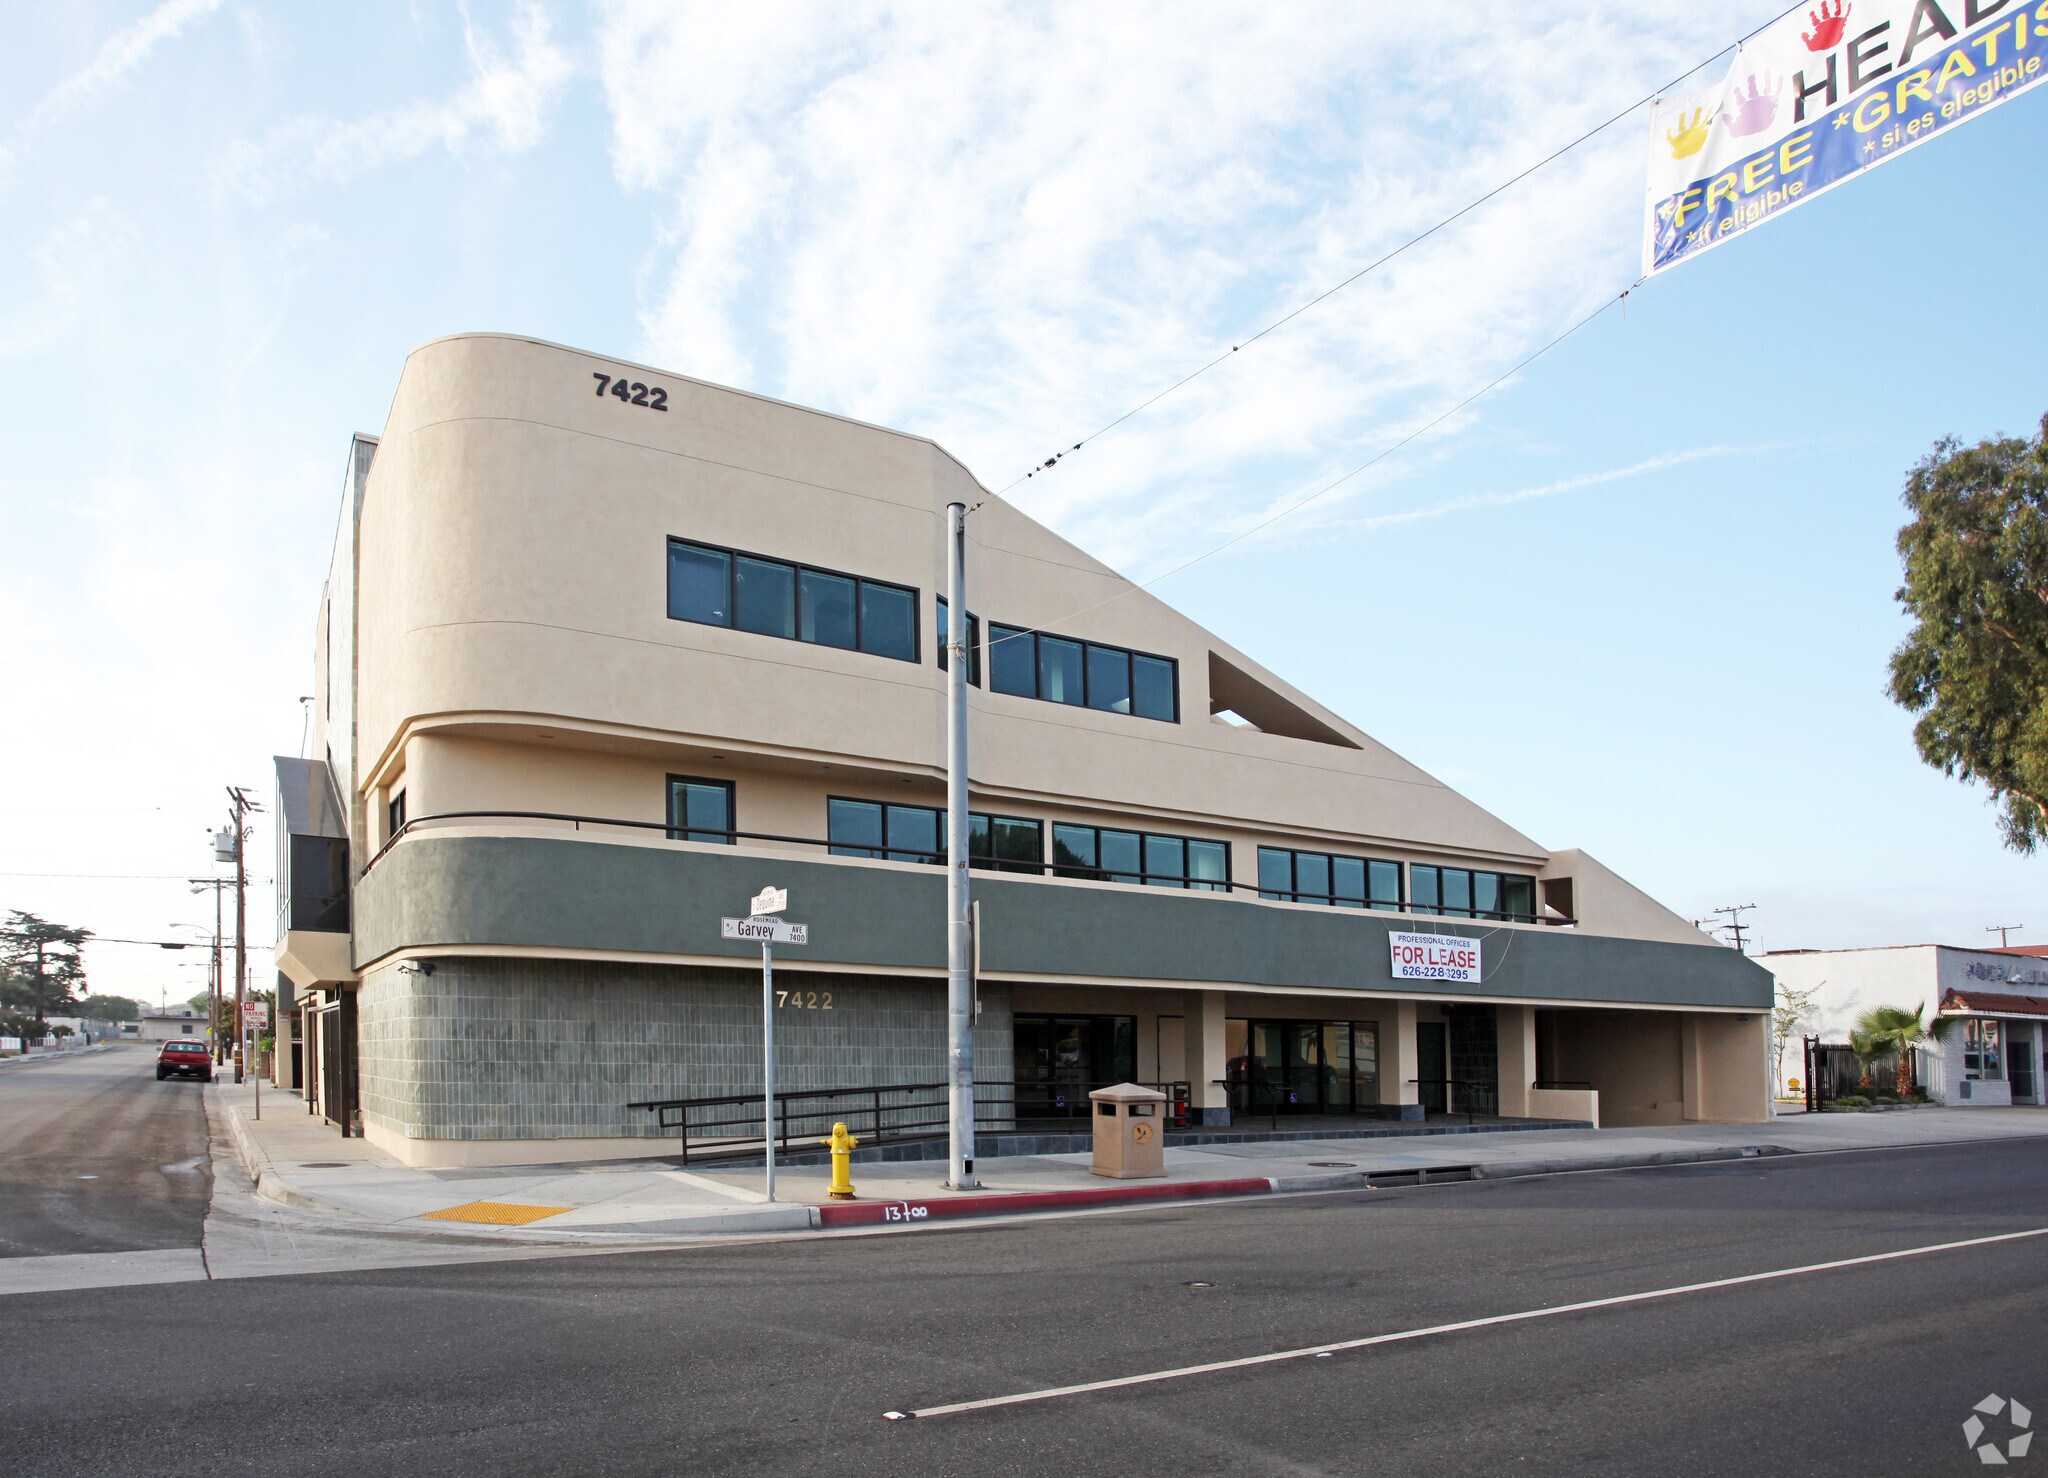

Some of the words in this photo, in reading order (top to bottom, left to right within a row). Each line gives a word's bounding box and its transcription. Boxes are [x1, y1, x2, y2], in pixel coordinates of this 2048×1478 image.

[1882, 124, 1900, 149] si
[1907, 111, 1935, 135] es
[1941, 56, 2042, 119] elegible
[1719, 181, 1804, 231] eligible
[593, 372, 668, 412] 7422
[753, 916, 779, 924] ROSEMEAD
[738, 920, 774, 940] Garvey
[789, 934, 805, 942] 7400
[791, 926, 803, 934] AVE
[1397, 935, 1445, 946] PROFESSIONAL
[1446, 938, 1471, 948] OFFICES
[1393, 945, 1424, 964] FOR
[1429, 948, 1476, 968] LEASE
[1402, 966, 1468, 979] 626-228-3295
[776, 991, 833, 1010] 7422
